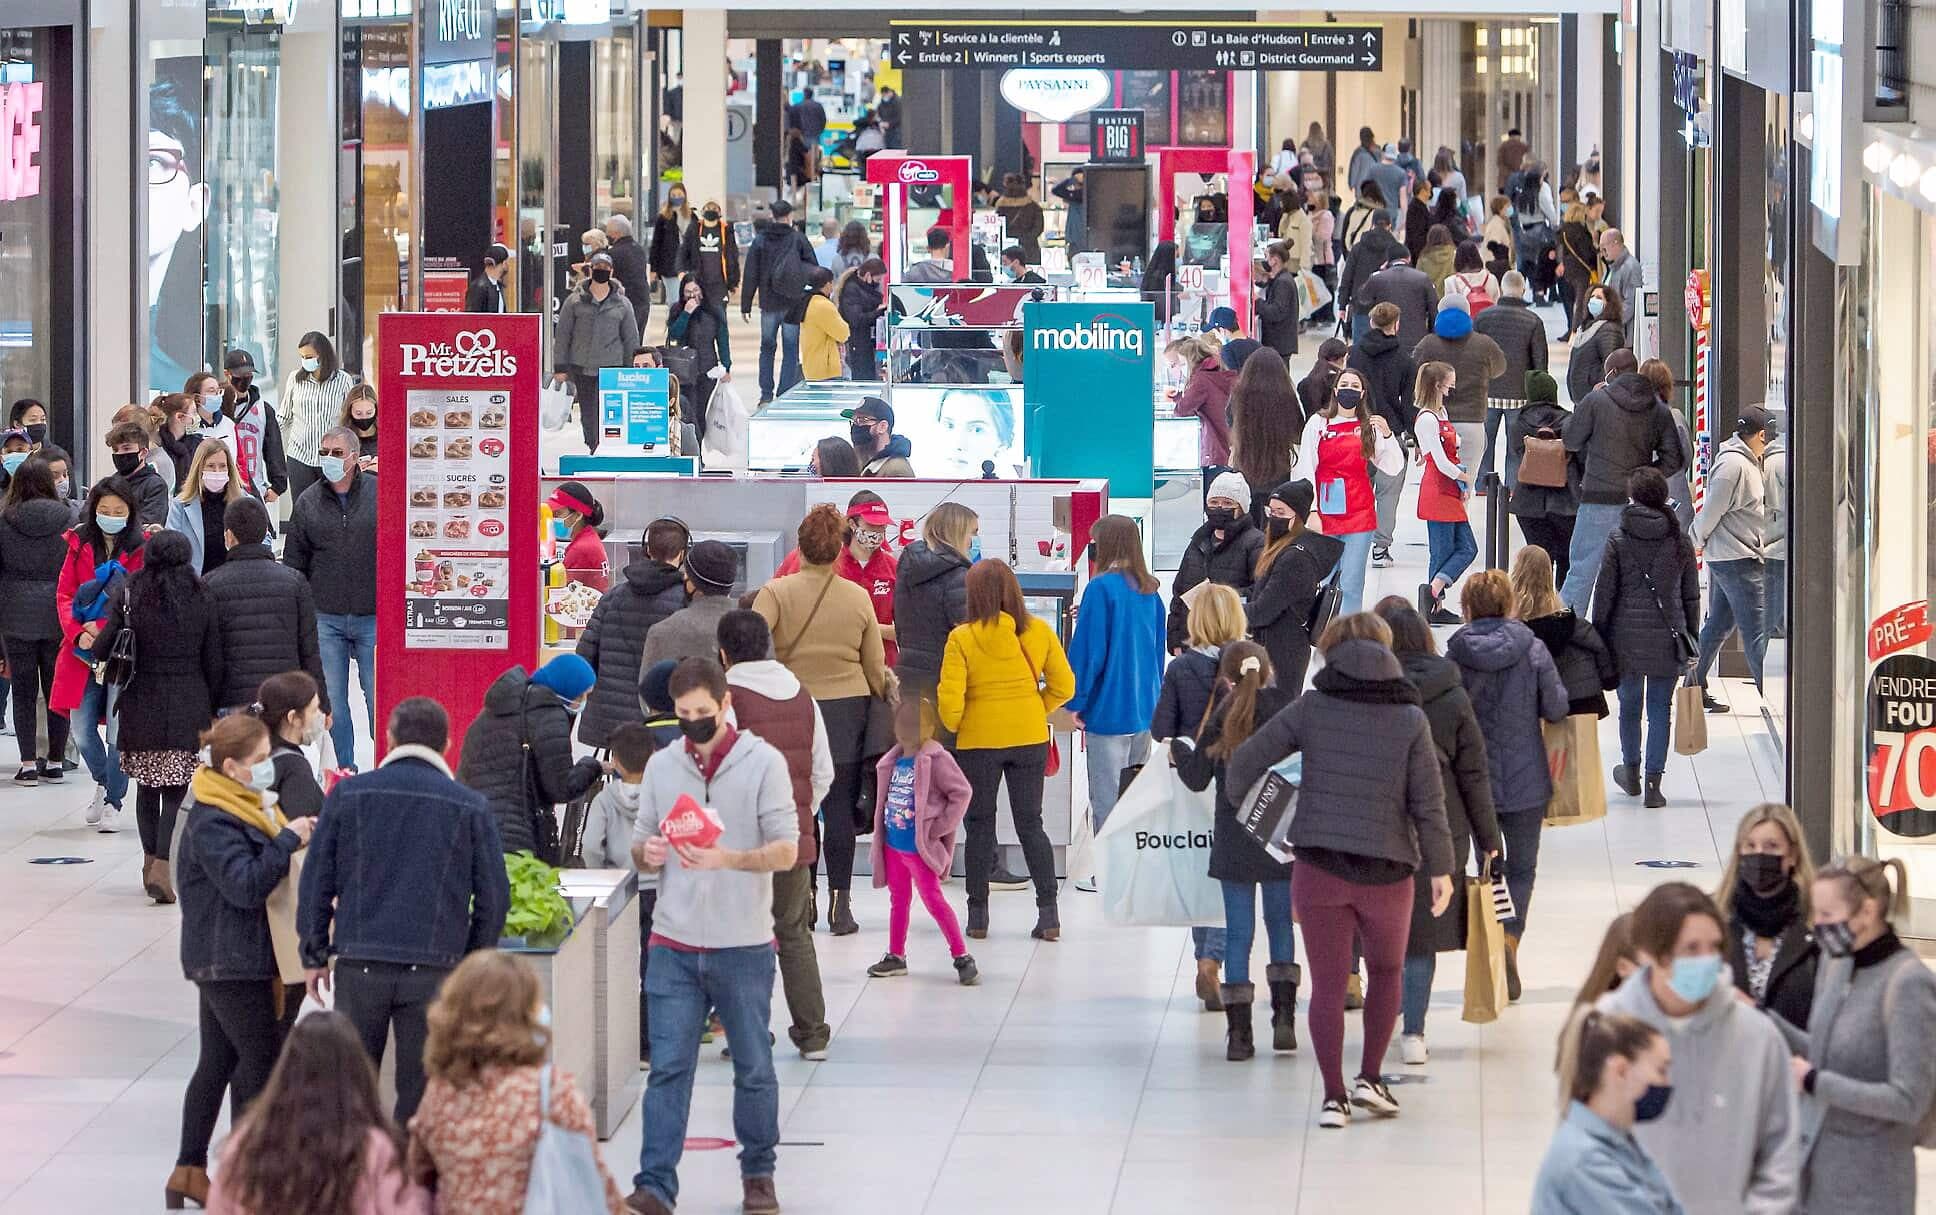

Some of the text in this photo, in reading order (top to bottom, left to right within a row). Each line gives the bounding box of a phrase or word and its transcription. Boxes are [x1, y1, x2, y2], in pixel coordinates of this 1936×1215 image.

[942, 31, 1043, 44] Service à la clientèle
[1211, 33, 1301, 45] La Baie d'Hudson
[1311, 33, 1354, 45] Entrée 3
[919, 51, 962, 63] Entrée 2
[974, 52, 1018, 63] Winners
[1030, 52, 1105, 65] Sports experts
[1260, 52, 1354, 64] District Gourmand
[1106, 125, 1128, 149] BIG
[1107, 150, 1128, 158] TIME
[1081, 267, 1101, 287] 20
[1180, 266, 1202, 289] 40
[1033, 322, 1142, 355] mobilinq
[429, 342, 453, 356] Mr.
[1887, 701, 1933, 726] FOU
[1135, 830, 1214, 850] Bouclai
